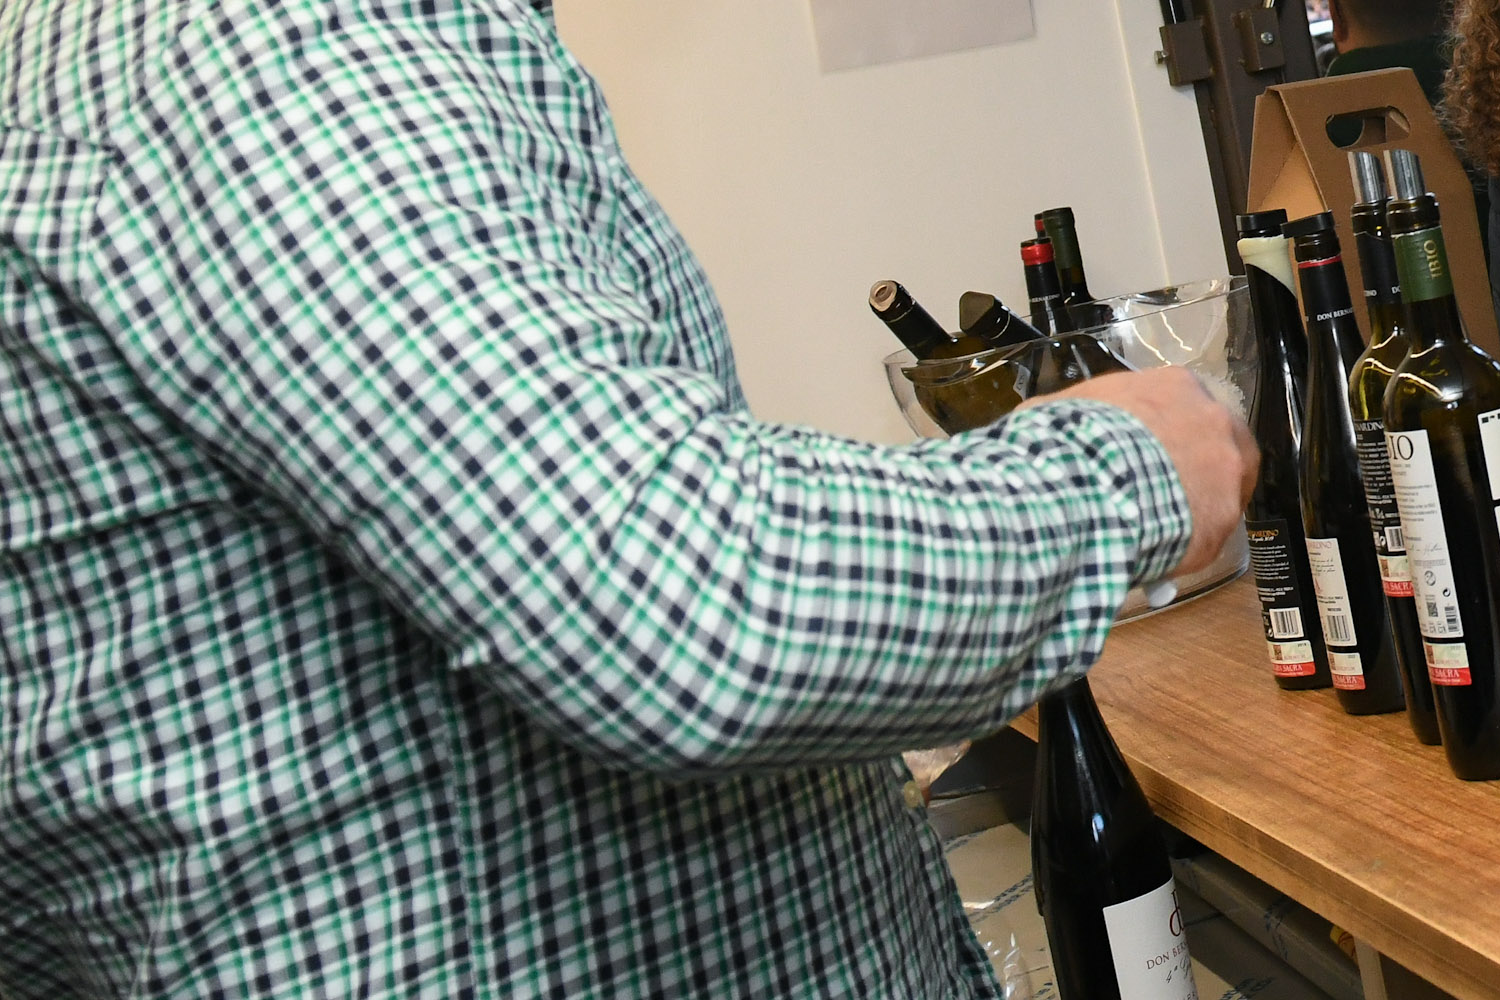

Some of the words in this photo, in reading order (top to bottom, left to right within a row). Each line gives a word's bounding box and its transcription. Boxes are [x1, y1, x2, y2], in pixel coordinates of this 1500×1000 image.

[1424, 239, 1443, 280] IBIO
[1317, 311, 1332, 321] DON
[1147, 952, 1170, 970] DON
